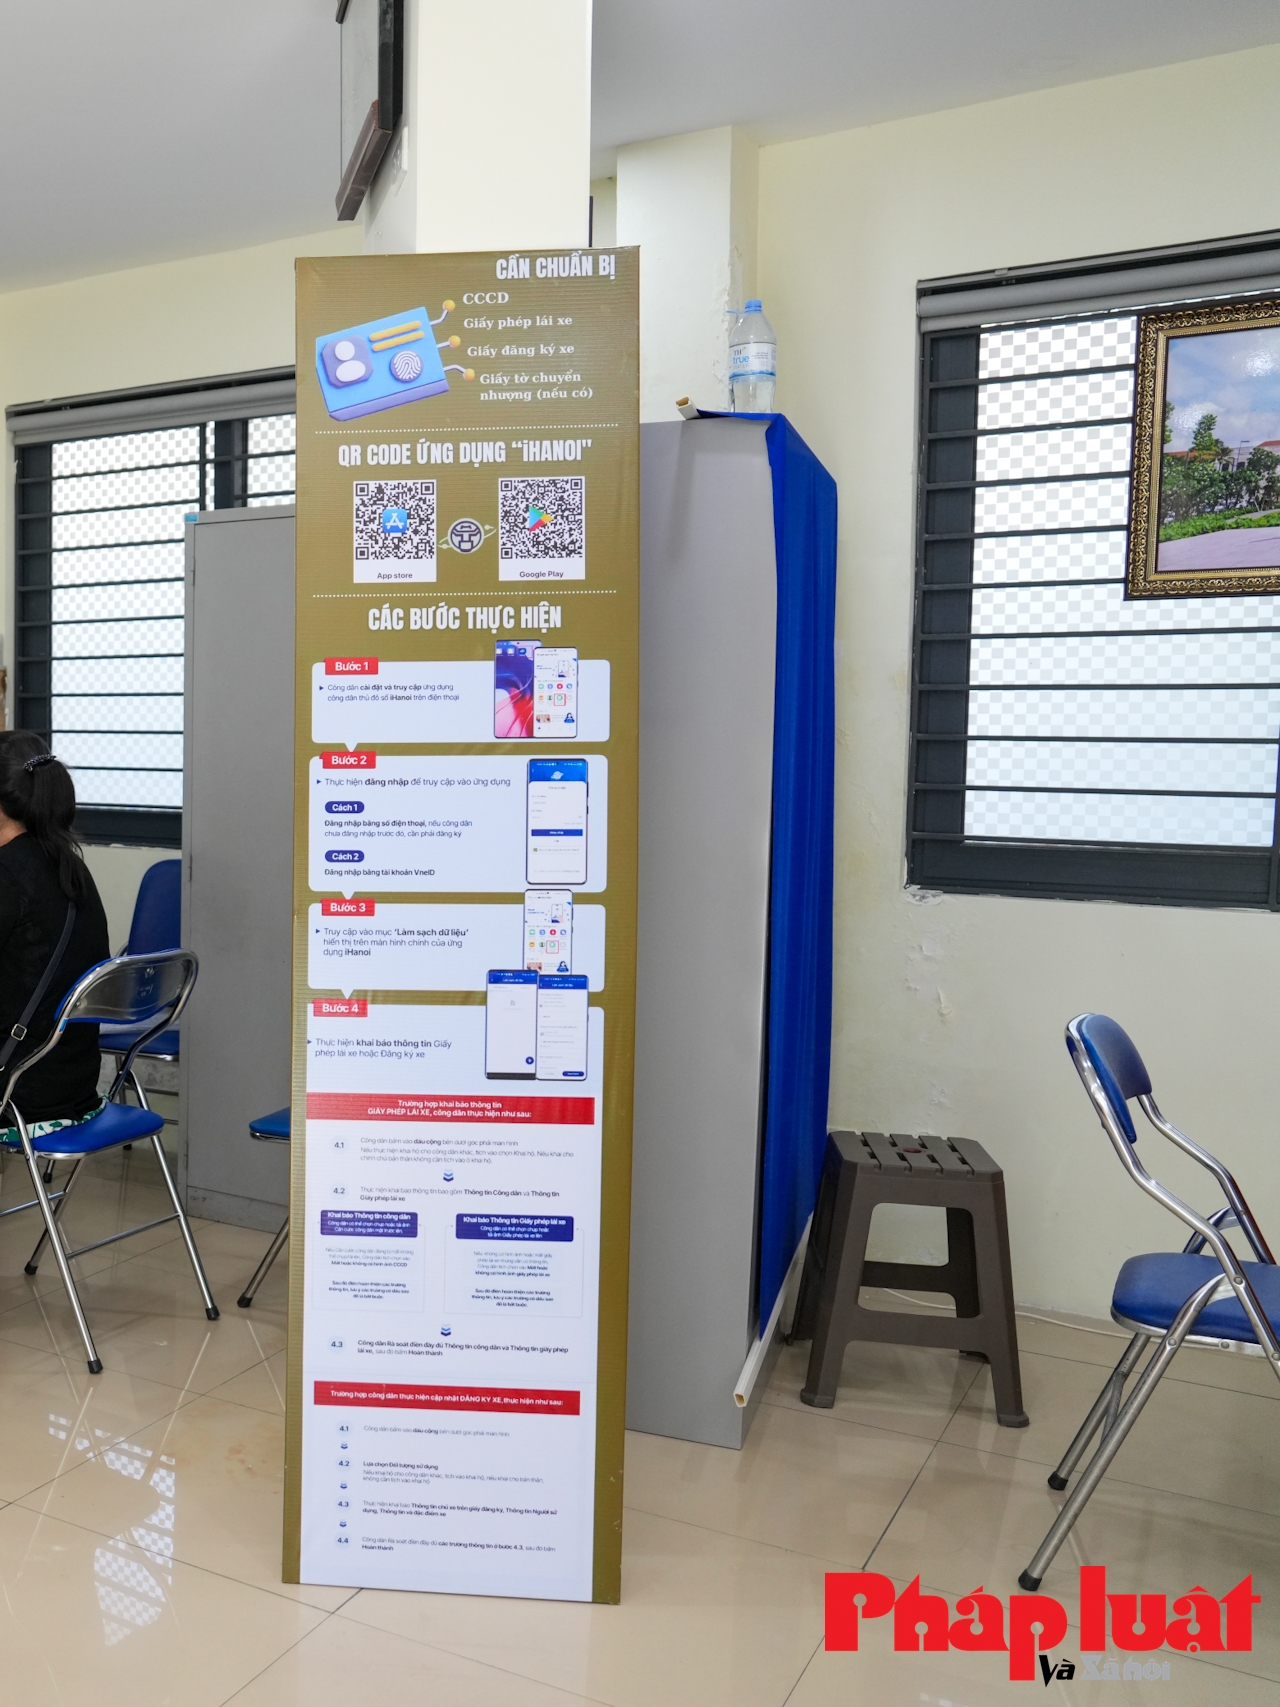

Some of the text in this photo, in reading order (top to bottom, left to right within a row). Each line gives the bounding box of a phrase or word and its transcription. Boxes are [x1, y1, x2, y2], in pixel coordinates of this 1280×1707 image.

[496, 253, 615, 279] CẦN CHUẨN BỊ
[463, 292, 509, 304] CCCD
[463, 315, 572, 330] Giấy phép lái xe
[467, 345, 498, 358] Giấy
[501, 345, 535, 357] đăng
[540, 343, 556, 356] ký
[480, 370, 581, 385] Giấy tờ chuyển
[480, 387, 593, 401] nhượng (nếu có)
[338, 445, 361, 466] QR
[367, 444, 411, 465] CODE
[417, 439, 453, 464] ỨNG
[459, 442, 506, 466] DỤNG
[519, 570, 564, 581] Google Play
[368, 601, 561, 633] CÁC BƯỚC THỰC HIỆN
[335, 661, 368, 671] Bước 1
[331, 755, 367, 765] Bước 2
[353, 852, 359, 860] 2
[330, 902, 366, 912] Bước 3
[321, 1003, 359, 1013] Bước 4
